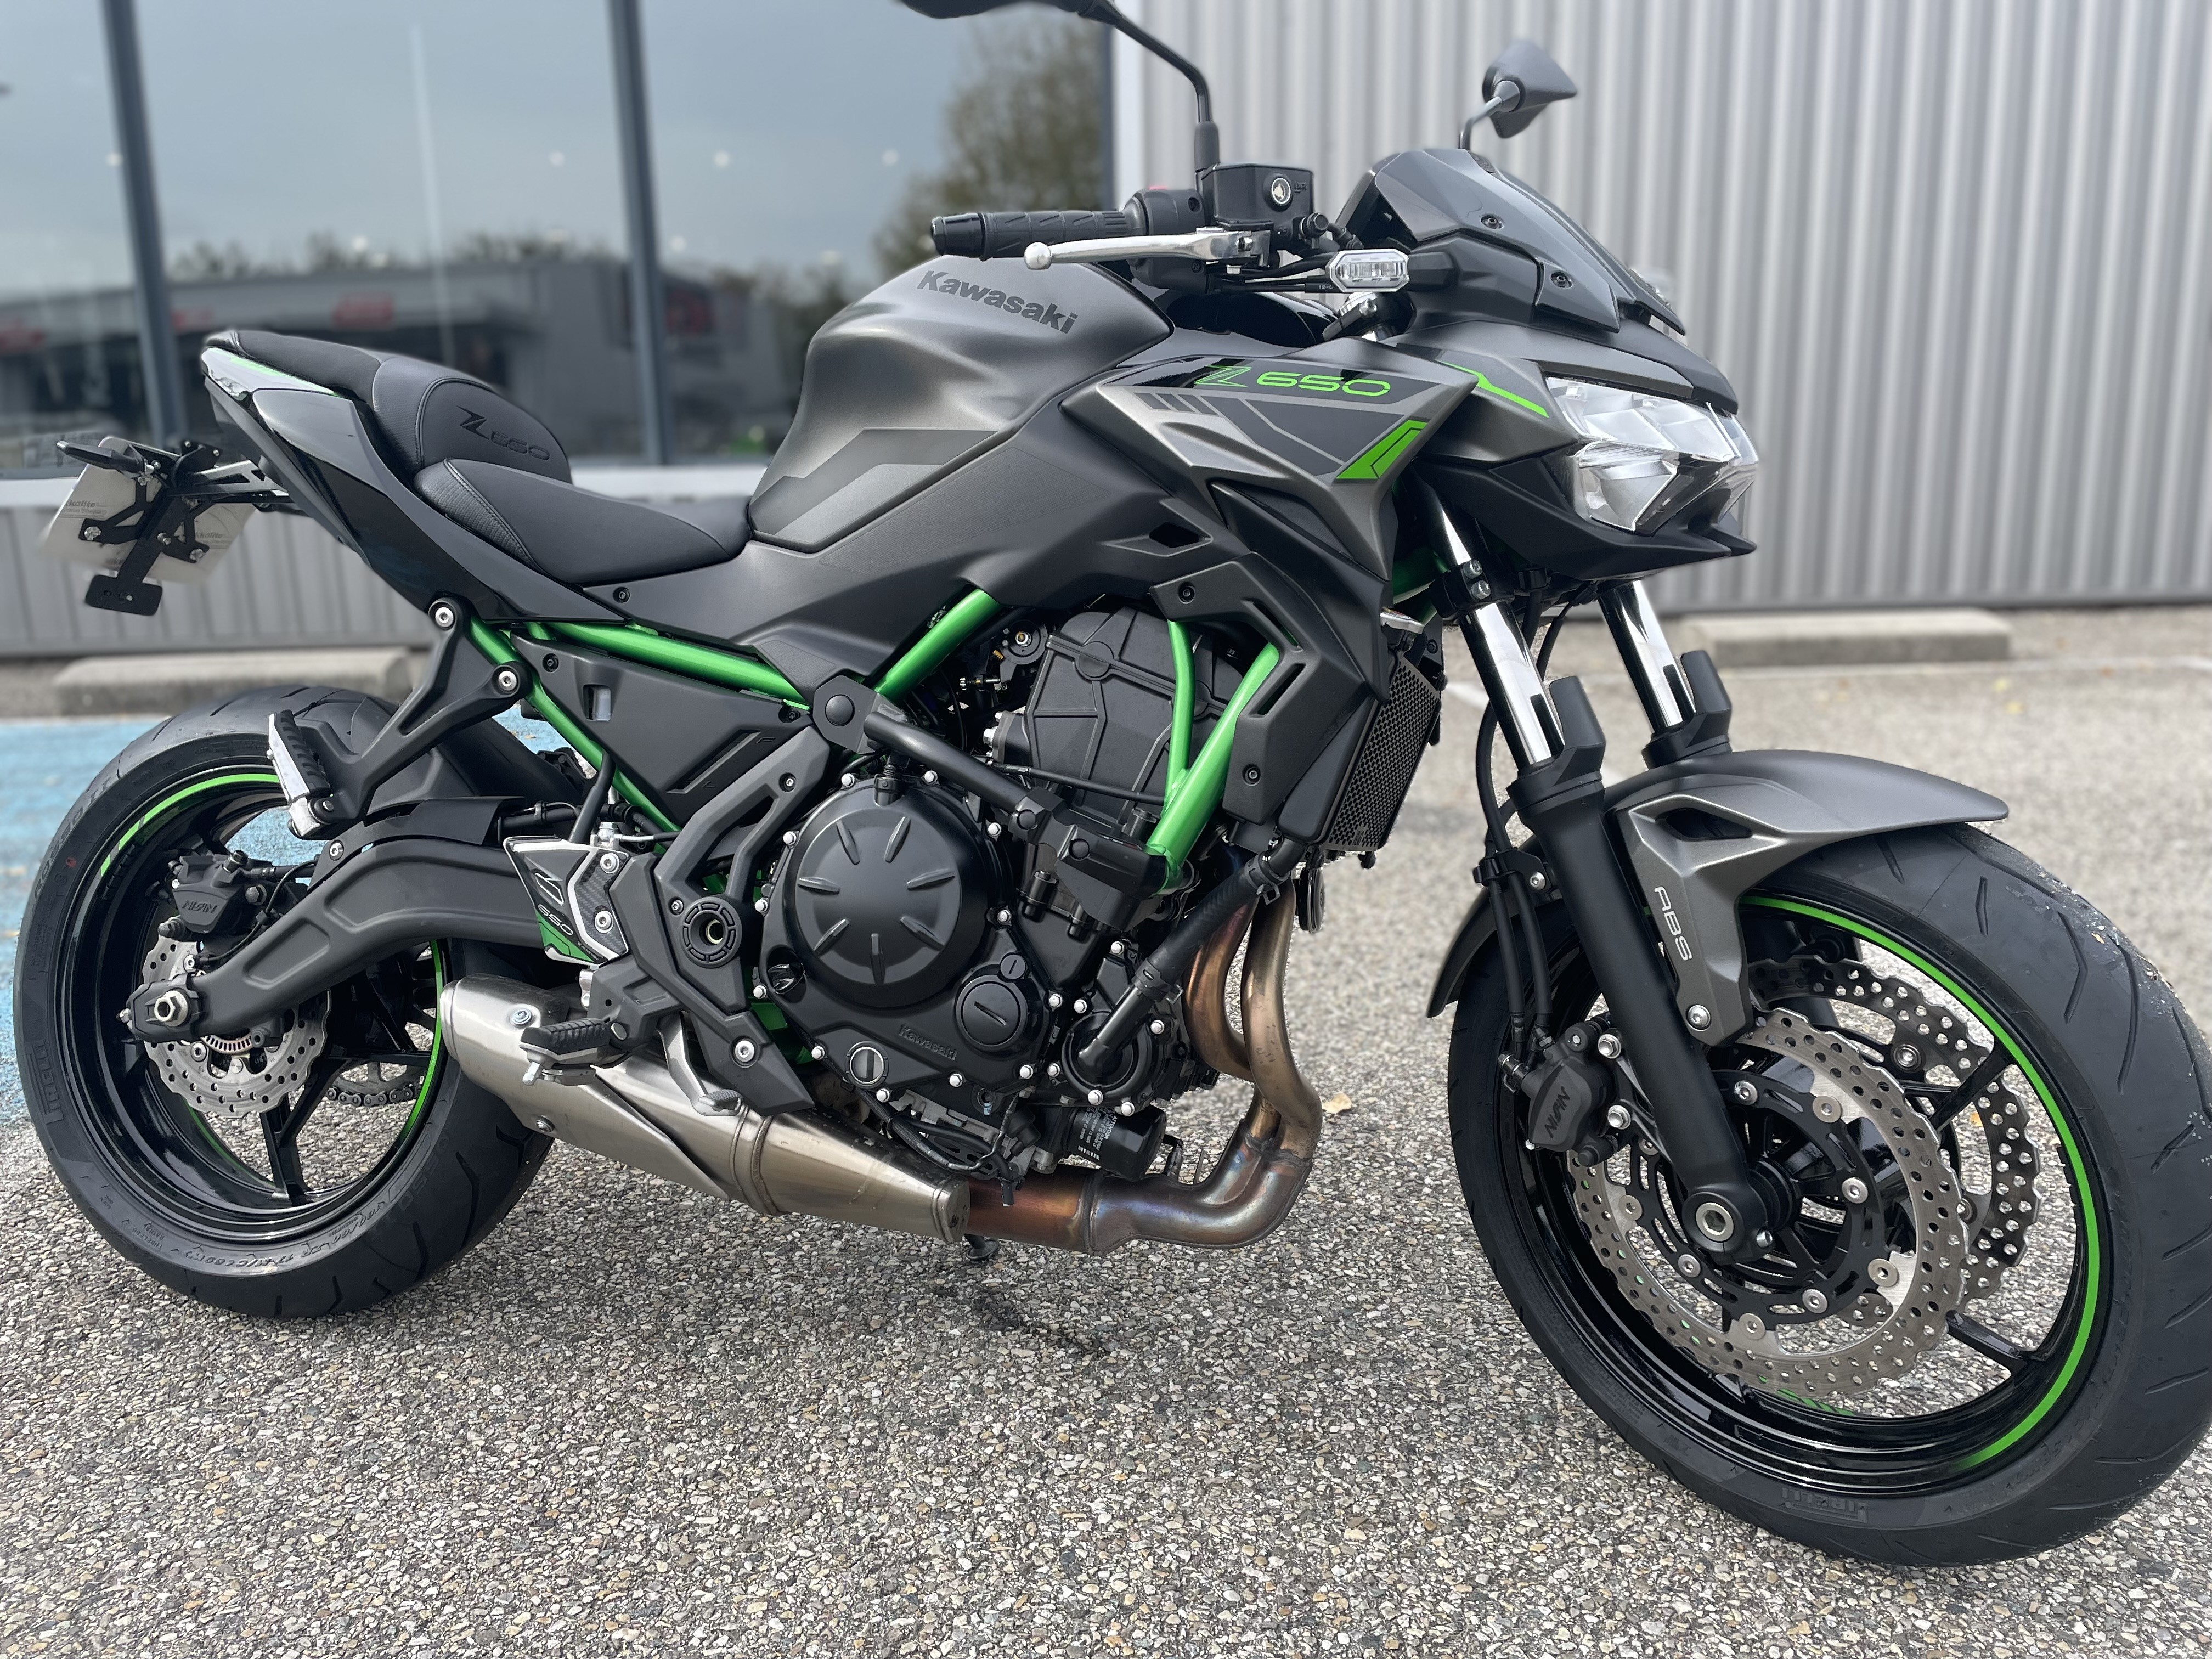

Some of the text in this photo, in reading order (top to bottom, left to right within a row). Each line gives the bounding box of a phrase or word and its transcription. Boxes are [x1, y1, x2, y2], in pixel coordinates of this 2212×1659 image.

[916, 270, 1079, 334] Kawasaki
[537, 904, 574, 936] 650
[1654, 886, 1692, 961] ABS
[899, 1024, 958, 1061] Kawasaki
[31, 1039, 65, 1125] PIRELLI
[1104, 1115, 1118, 1140] ATTENTION
[1782, 1487, 1867, 1523] PIRELLI
